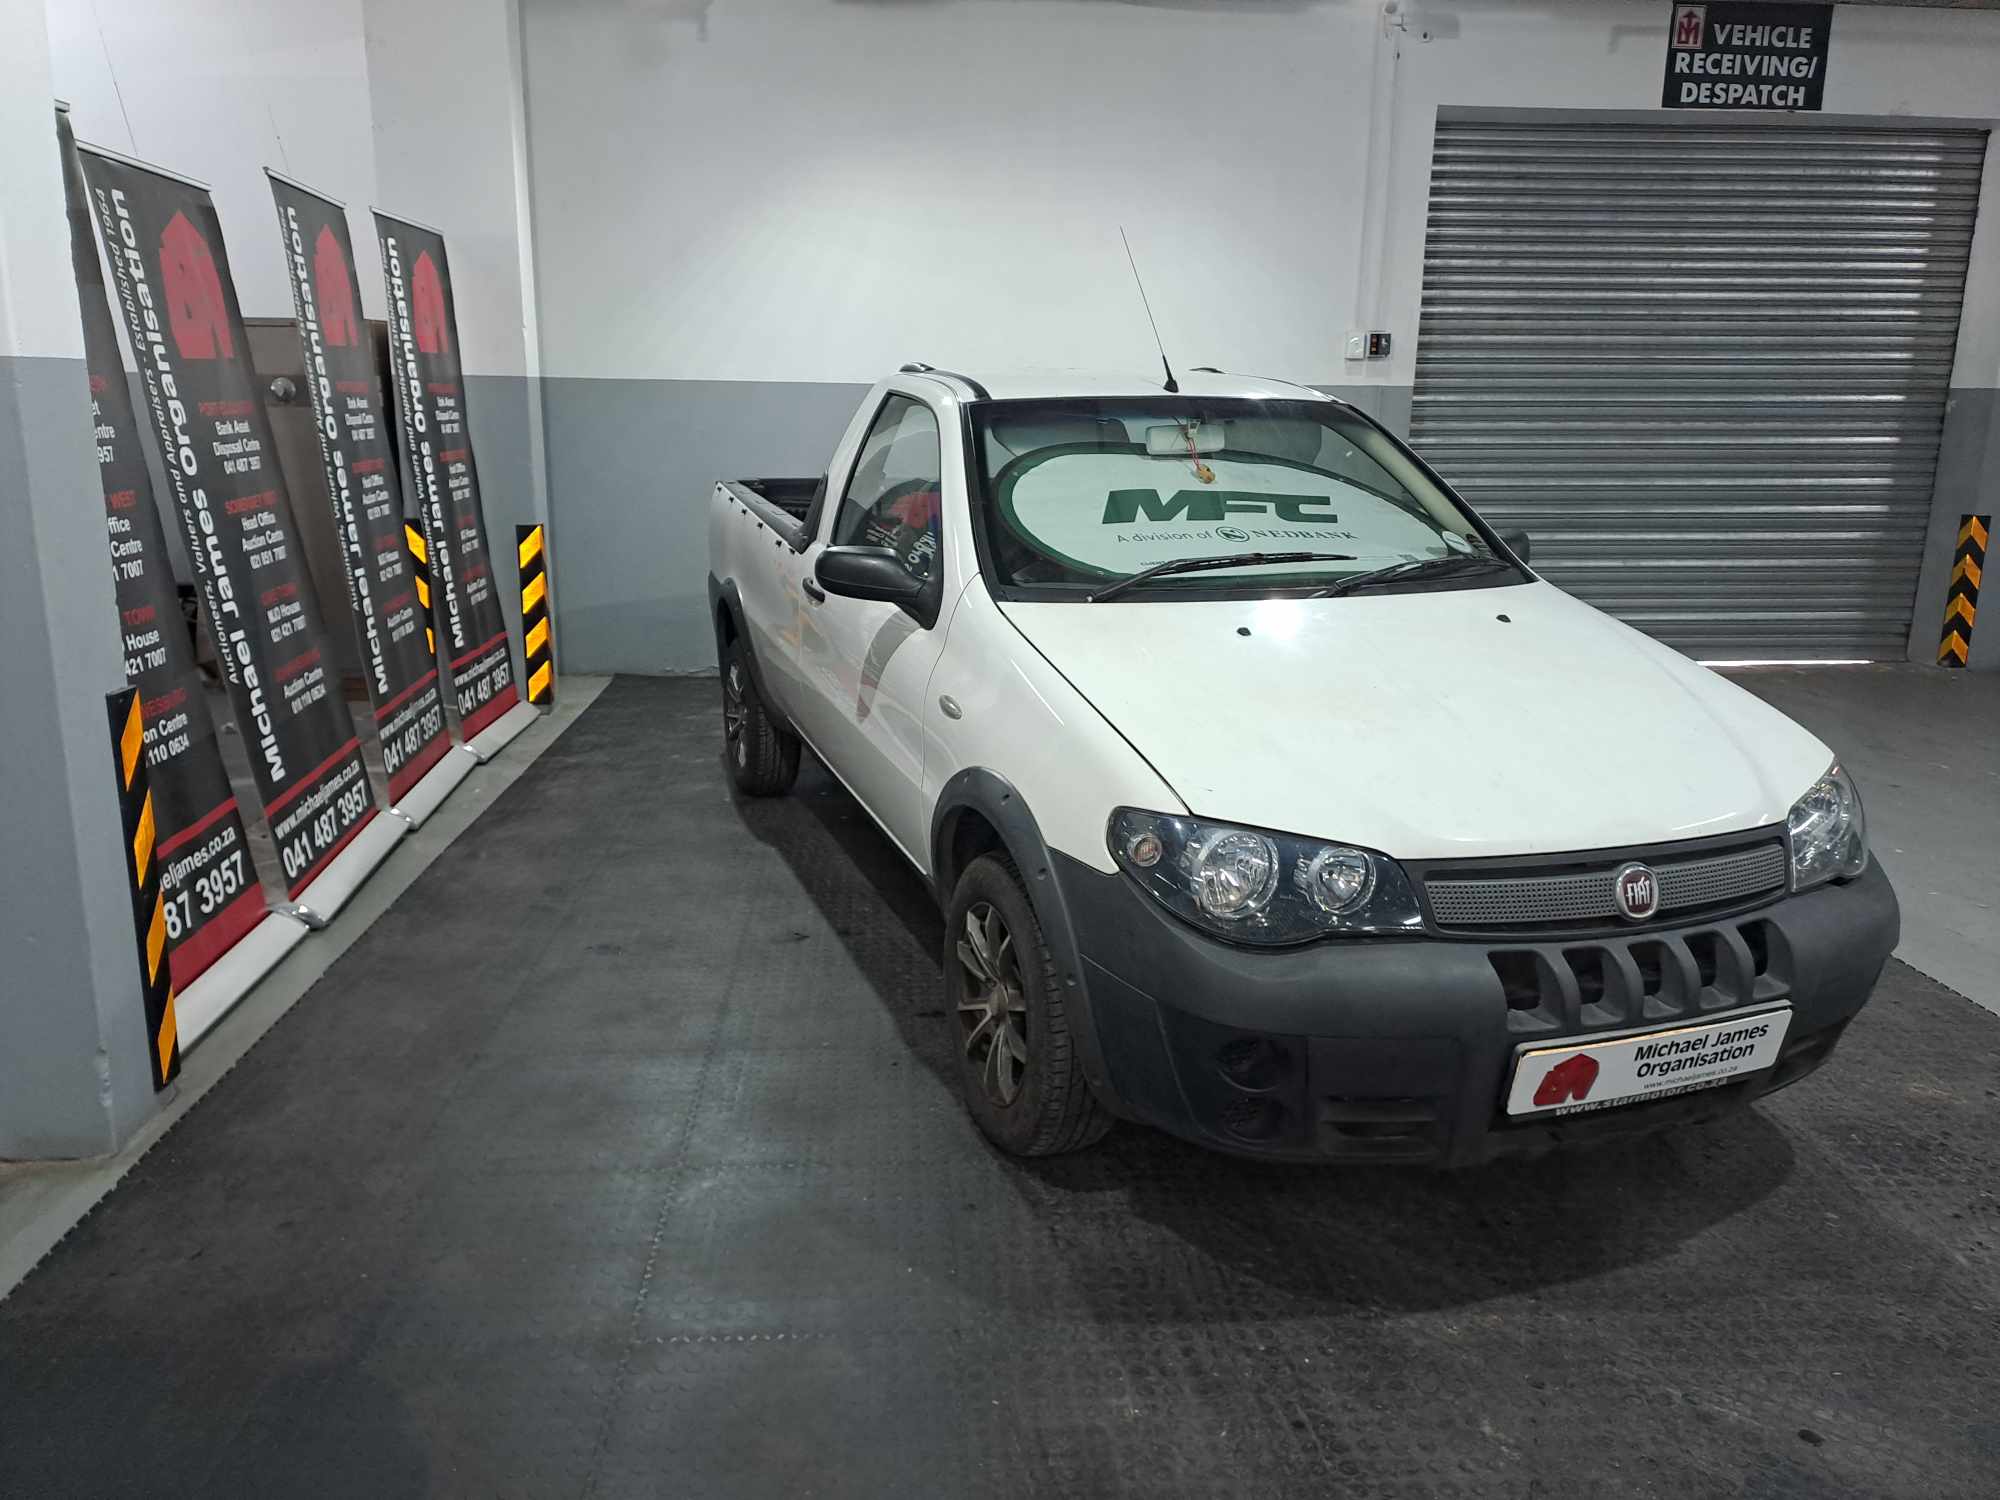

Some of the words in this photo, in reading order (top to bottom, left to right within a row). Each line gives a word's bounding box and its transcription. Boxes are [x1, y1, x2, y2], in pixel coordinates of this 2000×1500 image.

[1713, 23, 1813, 48] VEHICLE
[1674, 52, 1818, 78] RECEIVING/
[1680, 82, 1805, 107] DESPATCH
[94, 187, 116, 236] 1964
[108, 241, 146, 351] Established
[111, 188, 197, 476] Organisation
[286, 206, 338, 440] Organisation
[387, 237, 426, 433] Organisation
[94, 423, 116, 439] ntre
[144, 368, 176, 465] Appraisers
[405, 424, 417, 451] and
[97, 445, 114, 463] 957
[169, 468, 187, 503] and
[333, 449, 362, 558] James
[420, 440, 444, 533] James
[1102, 489, 1338, 524] MFC
[107, 516, 131, 534] ffice
[182, 509, 207, 573] Valuers
[1117, 534, 1129, 542] A
[1132, 531, 1194, 542] division
[1197, 530, 1213, 539] of
[1251, 529, 1360, 540] NEDBANK
[110, 538, 143, 557] Centre
[192, 488, 239, 618] James
[121, 560, 144, 580] 7007
[435, 540, 464, 649] Michael
[125, 630, 160, 651] House
[354, 568, 389, 694] Michael
[145, 648, 167, 668] 7007
[229, 629, 286, 782] Michael
[457, 688, 477, 715] 041
[477, 675, 492, 701] 487
[492, 662, 510, 691] 3957
[158, 711, 188, 741] Centre
[383, 739, 404, 774] 041
[405, 722, 421, 756] 487
[420, 704, 441, 740] 3957
[283, 831, 313, 878] 041
[314, 806, 338, 848] 487
[337, 779, 368, 826] 3957
[160, 826, 236, 892] eljames.co.za
[164, 891, 193, 940] 87
[195, 850, 245, 915] 3957
[1626, 876, 1650, 906] FIAT
[1634, 1034, 1710, 1061] Michael
[1711, 1024, 1769, 1048] James
[1637, 1044, 1755, 1077] Organisation
